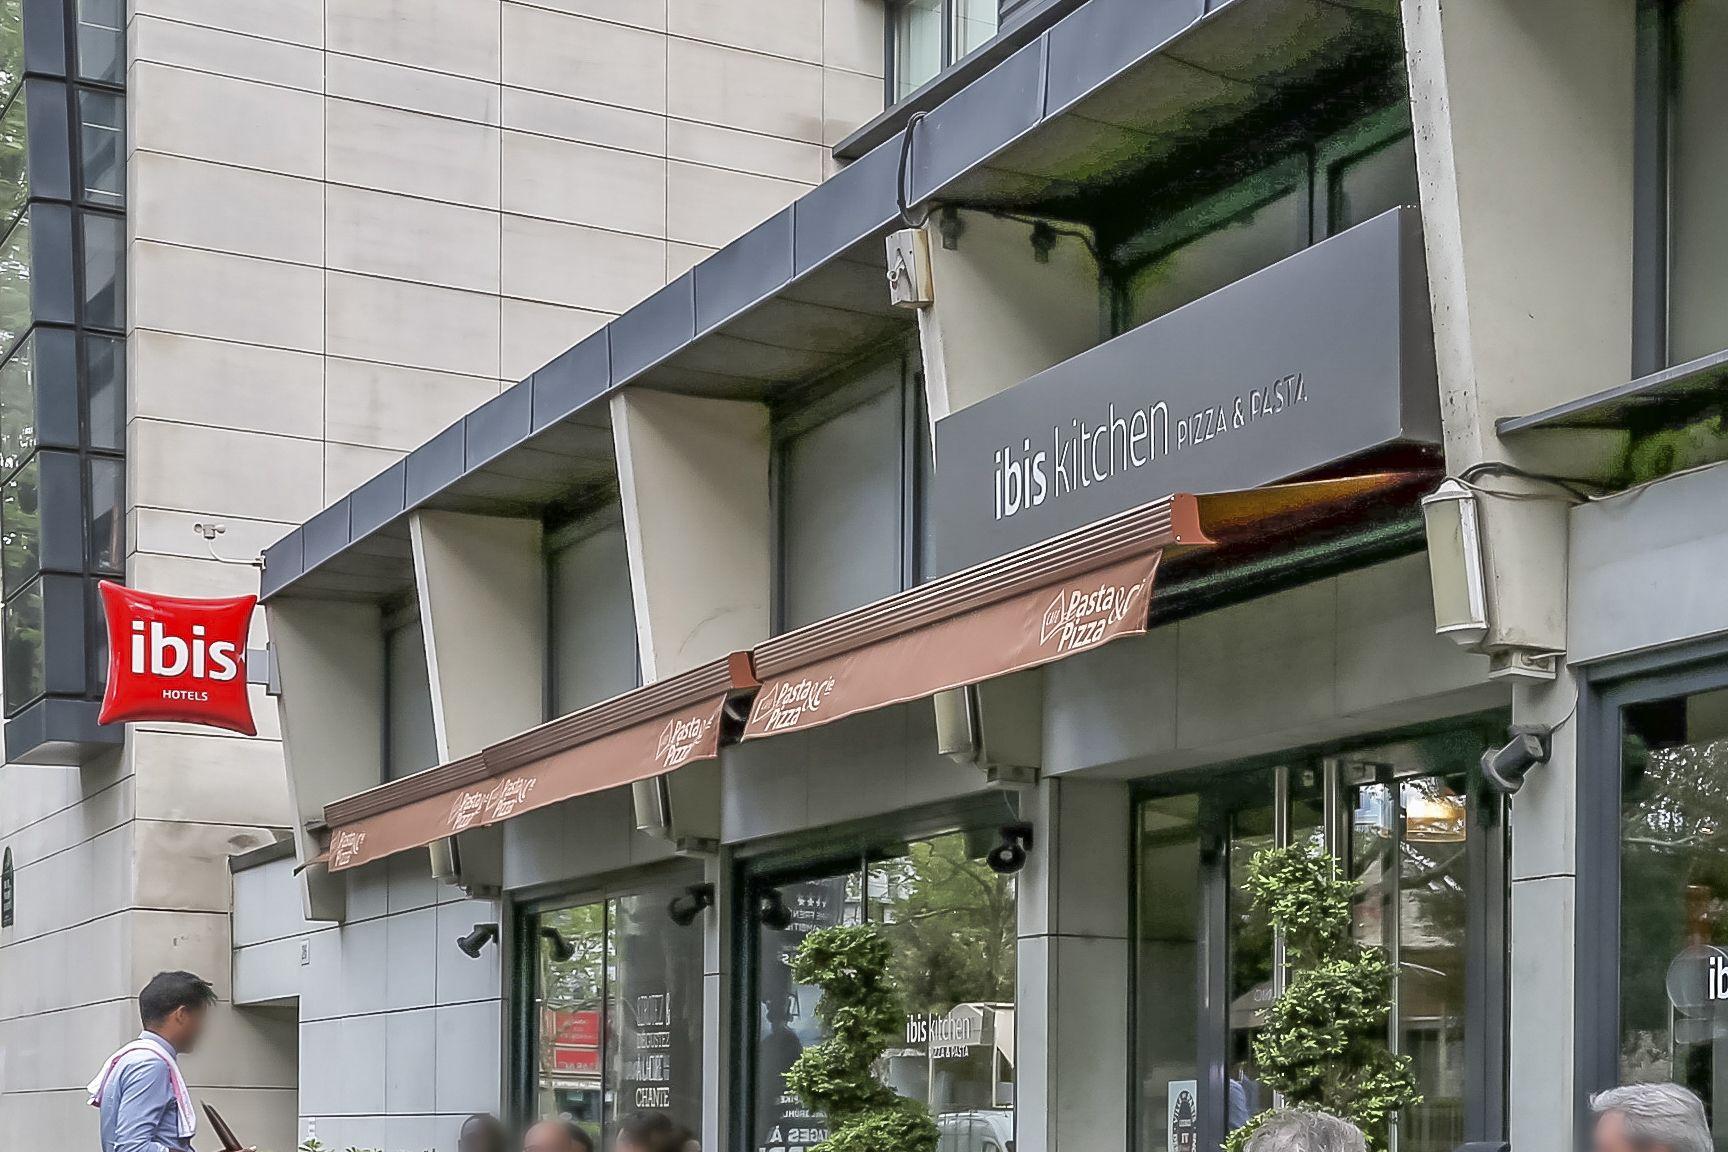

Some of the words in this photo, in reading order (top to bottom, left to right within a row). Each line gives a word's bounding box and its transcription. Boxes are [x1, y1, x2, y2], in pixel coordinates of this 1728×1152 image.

[994, 438, 1047, 520] ibis
[1054, 400, 1168, 497] kitchen
[1177, 405, 1227, 450] PIZZA
[1232, 396, 1245, 429] &
[1250, 372, 1308, 422] PASTA
[131, 620, 237, 681] ibis
[1057, 618, 1106, 652] Pizza
[162, 689, 208, 701] HOTELS
[764, 706, 801, 731] Pizza
[907, 1013, 927, 1043] ibis
[929, 1011, 970, 1042] kitchen
[636, 1087, 670, 1108] CHANTE
